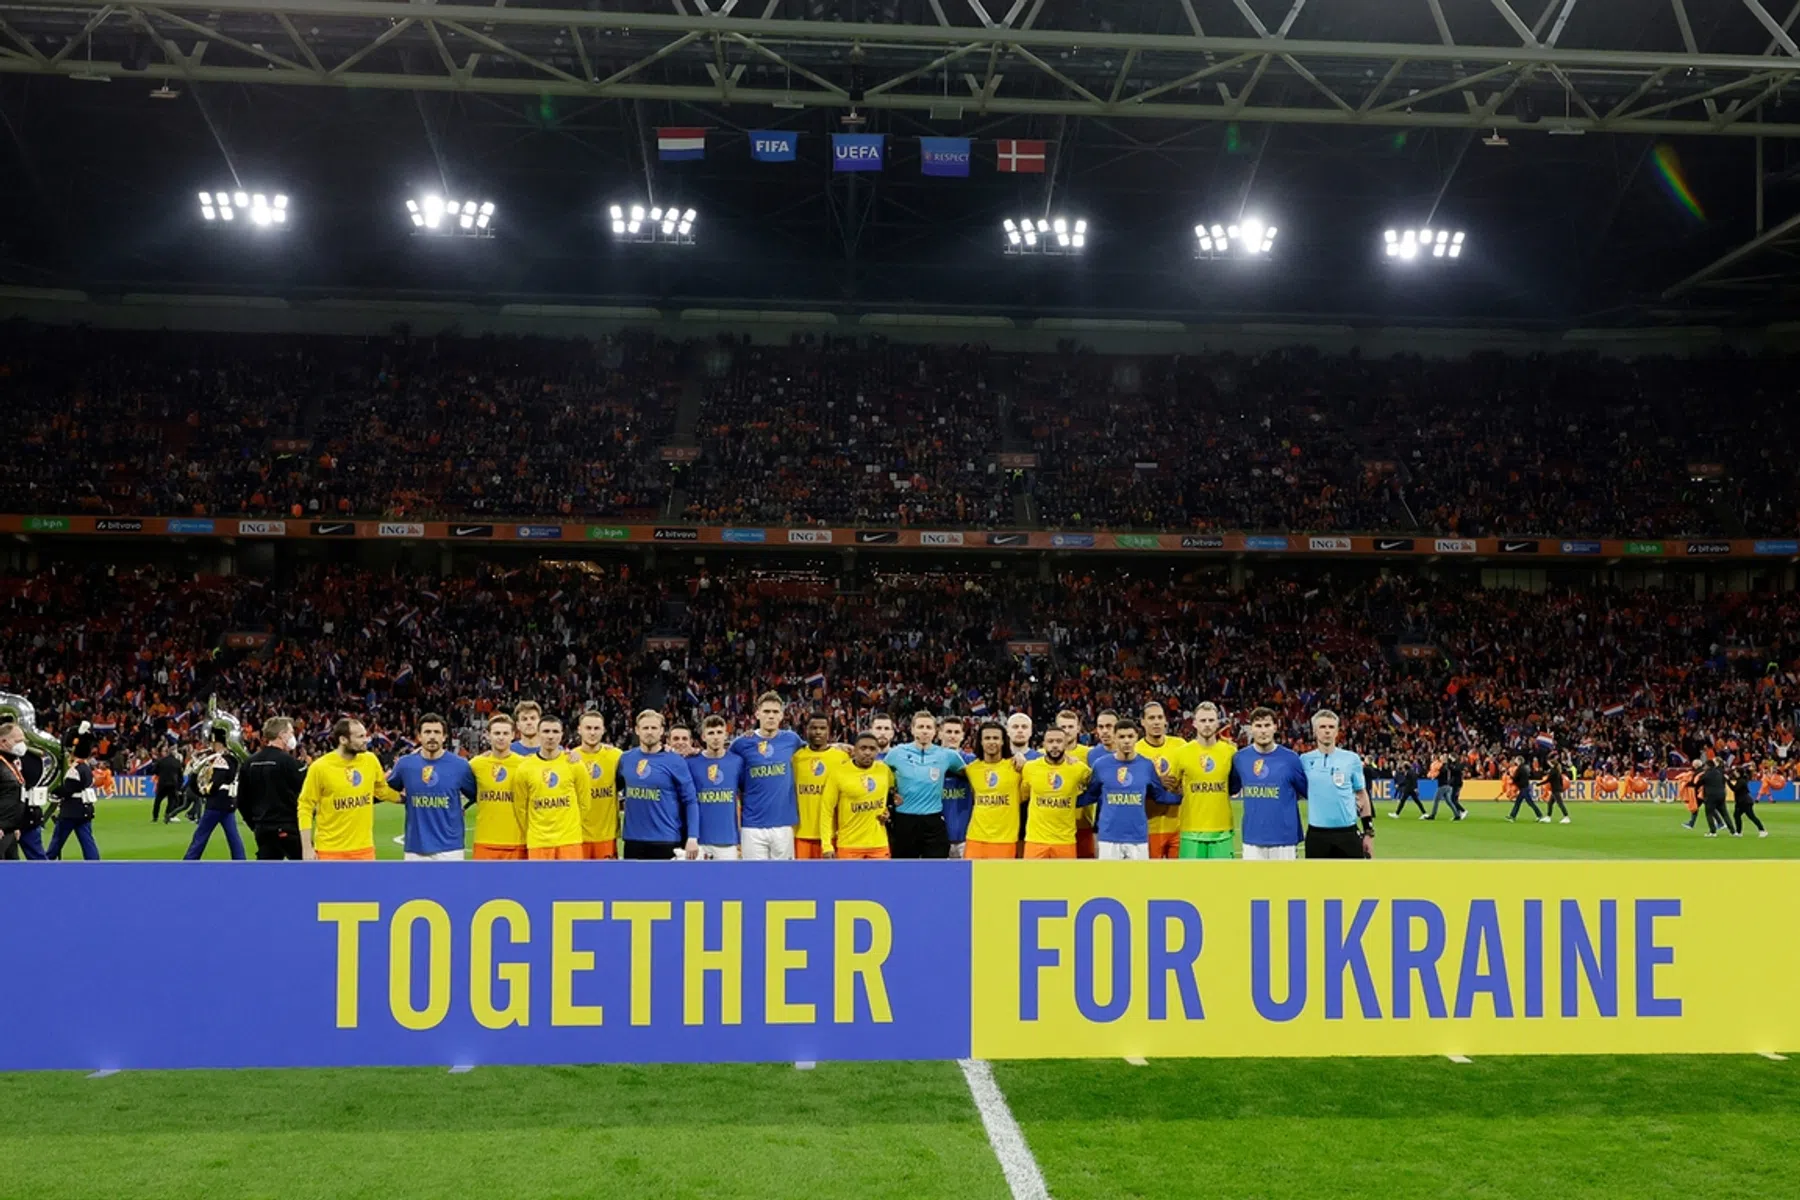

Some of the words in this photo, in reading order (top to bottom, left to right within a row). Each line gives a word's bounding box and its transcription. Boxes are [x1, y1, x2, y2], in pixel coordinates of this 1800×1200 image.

[756, 140, 790, 153] FIFA
[836, 146, 879, 159] UEFA
[934, 152, 970, 163] RESPECT
[43, 519, 63, 530] kpn
[108, 520, 142, 530] bitvavo
[241, 522, 266, 533] ING
[380, 525, 405, 535] ING
[604, 529, 624, 539] kpn
[665, 530, 697, 539] bitvavo
[790, 532, 814, 541] ING
[923, 534, 945, 544] ING
[1312, 539, 1334, 549] ING
[1437, 541, 1459, 550] ING
[1640, 544, 1658, 554] kpn
[1698, 544, 1730, 553] bitvavo
[750, 763, 786, 778] UKRAINE
[590, 785, 614, 800] RAINE
[626, 787, 661, 801] UKRAINE
[943, 787, 966, 800] RAINE
[1190, 782, 1226, 794] UKRAINE
[1243, 785, 1280, 799] UKRAINE
[333, 792, 371, 811] UKRAINE
[533, 795, 570, 810] UKRAINE
[697, 790, 734, 803] UKRAINE
[976, 794, 1010, 806] UKRAINE
[1036, 796, 1071, 809] UKRAINE
[1106, 792, 1143, 806] UKRAINE
[850, 799, 885, 813] UKRAINE
[319, 899, 892, 1029] TOGETHER
[1020, 898, 1204, 1022] FOR
[1252, 900, 1682, 1021] UKRAINE
